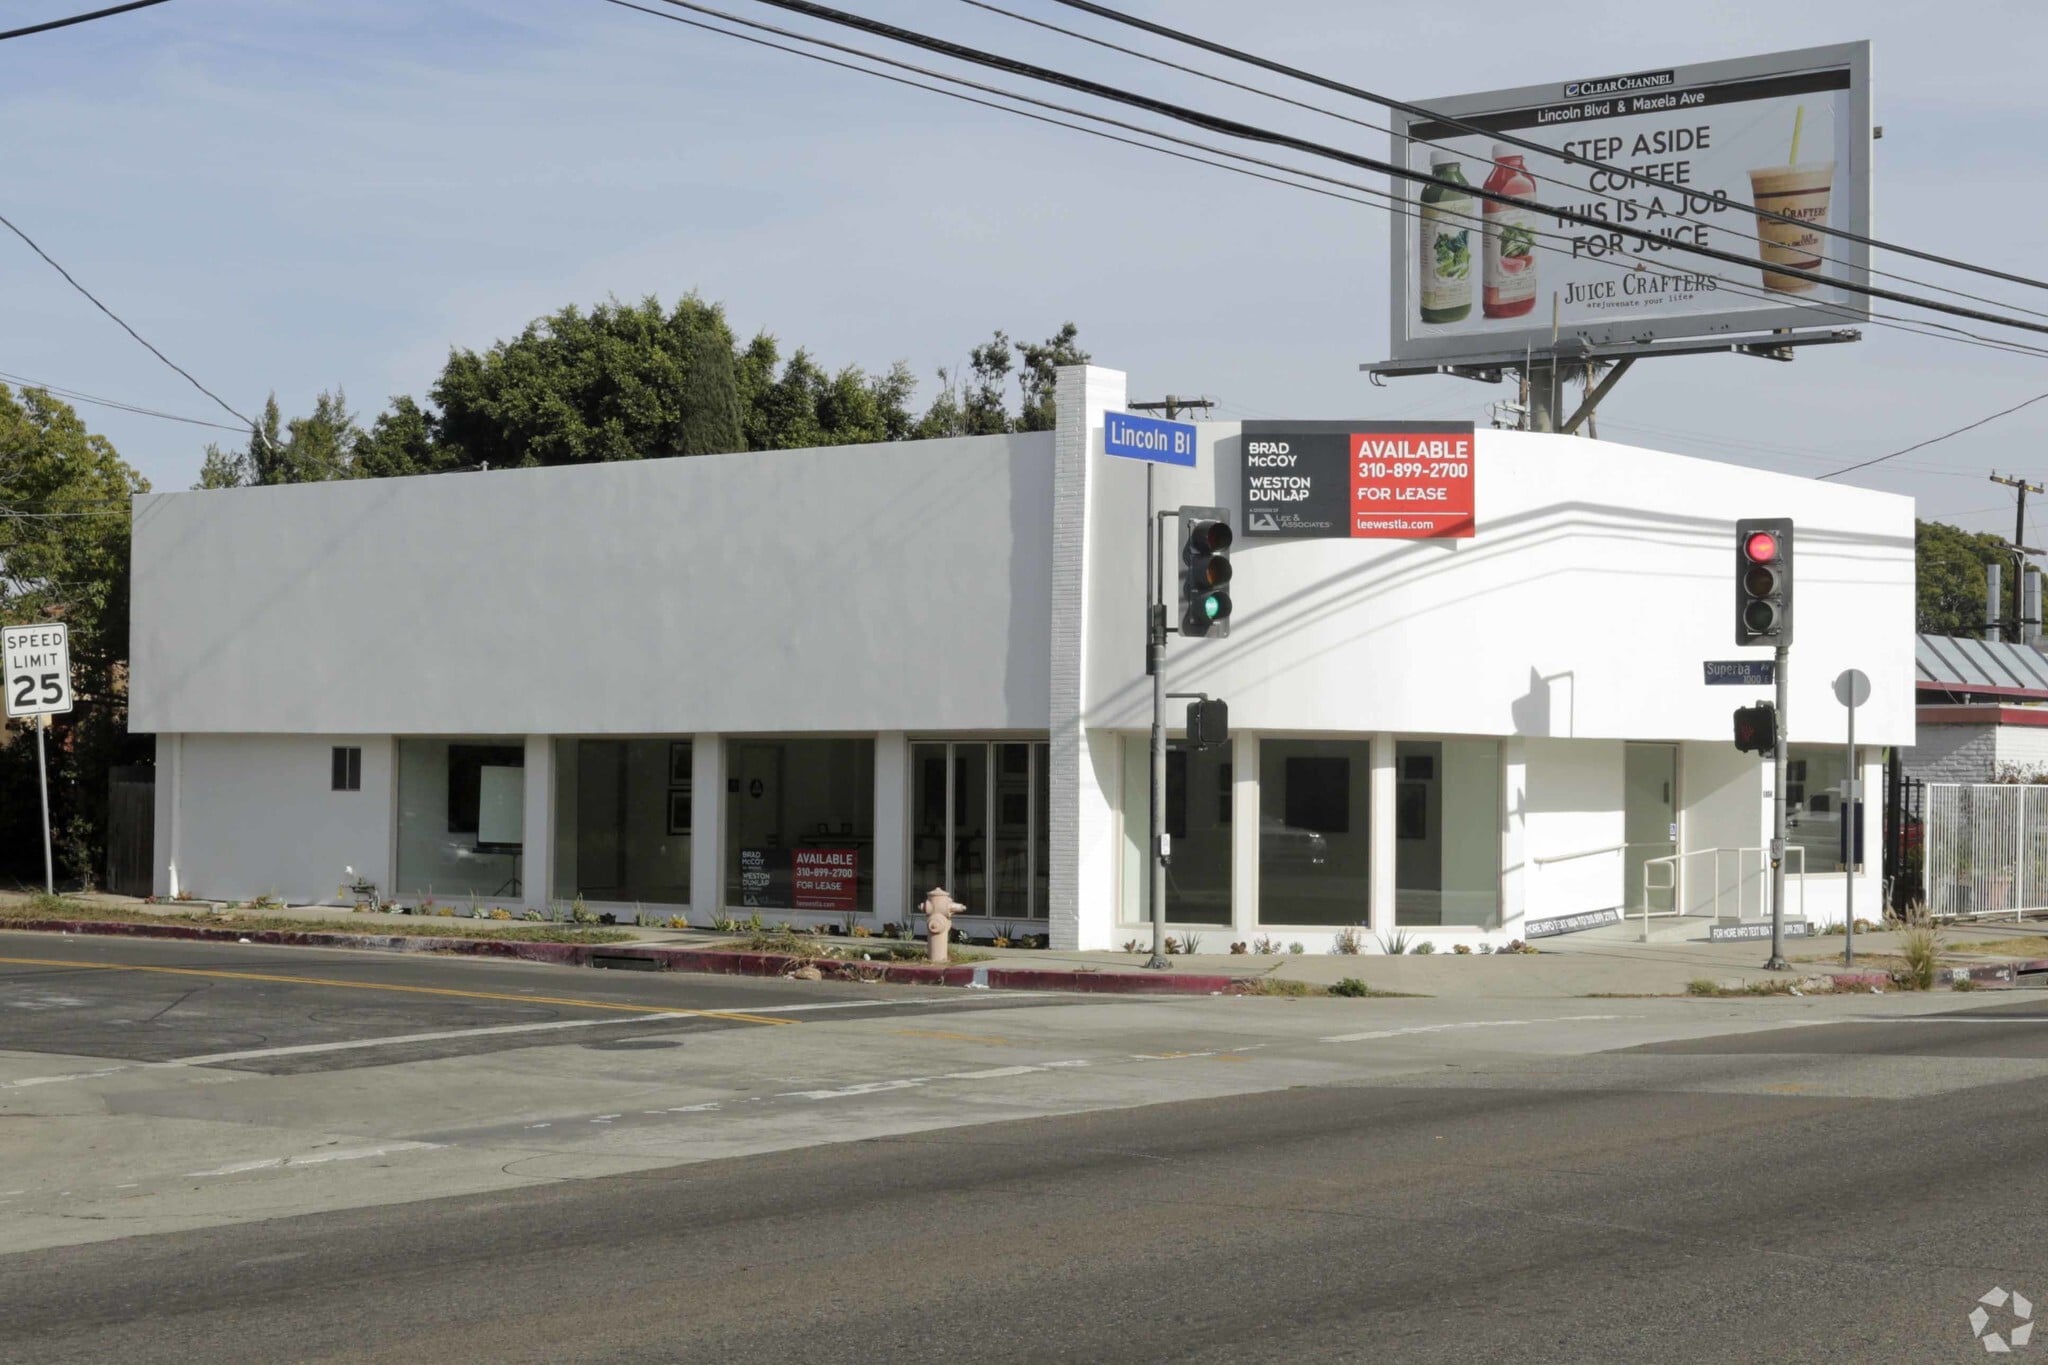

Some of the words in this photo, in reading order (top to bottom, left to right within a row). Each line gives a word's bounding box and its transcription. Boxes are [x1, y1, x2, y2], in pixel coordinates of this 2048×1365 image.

[1538, 104, 1581, 123] Lincoln
[1584, 102, 1610, 117] Blvd
[1617, 101, 1626, 113] &
[1633, 95, 1676, 111] Maxela
[1680, 92, 1705, 105] Ave
[1563, 136, 1623, 164] STEP
[1631, 126, 1710, 157] ASIDE
[1590, 161, 1690, 192] COFFEE
[1556, 201, 1608, 229] THIS
[1617, 199, 1638, 223] IS
[1646, 196, 1667, 220] A
[1676, 189, 1728, 216] JOB
[1572, 233, 1624, 259] FOR
[1633, 224, 1709, 253] JUICE
[1565, 281, 1616, 304] JUICE
[1623, 273, 1718, 296] CRAFTERS
[1644, 298, 1664, 307] your
[1111, 421, 1168, 452] Lincoln
[1174, 431, 1191, 455] Bl
[1248, 442, 1290, 454] BRAD
[1358, 440, 1469, 459] AVAILABLE
[1248, 455, 1298, 467] McCOY
[1358, 462, 1469, 478] 310-899-2700
[1250, 477, 1311, 489] WESTON
[1249, 489, 1310, 501] DUNLAP
[1357, 487, 1391, 500] FOR
[1395, 487, 1448, 500] LEASE
[1357, 519, 1434, 529] leewestla.com
[7, 633, 63, 649] SPEED
[14, 652, 58, 669] LIMIT
[1706, 662, 1751, 677] Superba
[13, 673, 63, 707] 25
[742, 850, 761, 858] BRAD
[796, 853, 853, 865] AVAILABLE
[743, 872, 770, 880] WESTON
[796, 867, 853, 878] 310-899-2700
[796, 881, 813, 890] FOR
[815, 881, 842, 891] LEASE
[1713, 928, 1723, 938] FOR
[1723, 927, 1737, 938] MORE
[1737, 927, 1748, 937] INFO
[1748, 926, 1760, 937] TEXT
